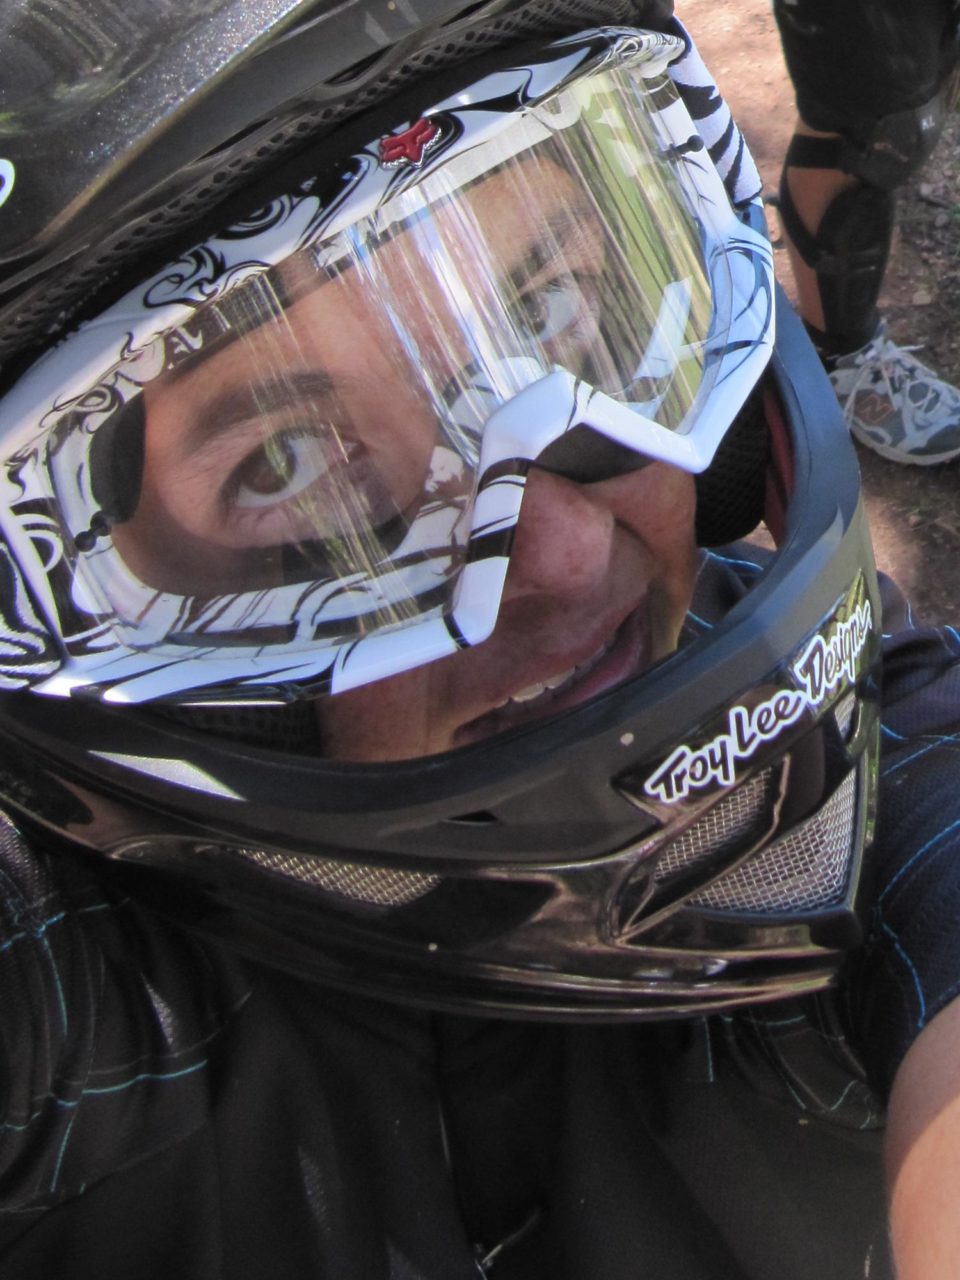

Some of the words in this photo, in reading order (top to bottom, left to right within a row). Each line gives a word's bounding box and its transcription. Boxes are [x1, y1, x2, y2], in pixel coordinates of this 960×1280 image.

[644, 735, 735, 803] Troy
[729, 689, 806, 757] Lee
[793, 600, 872, 705] Designs
